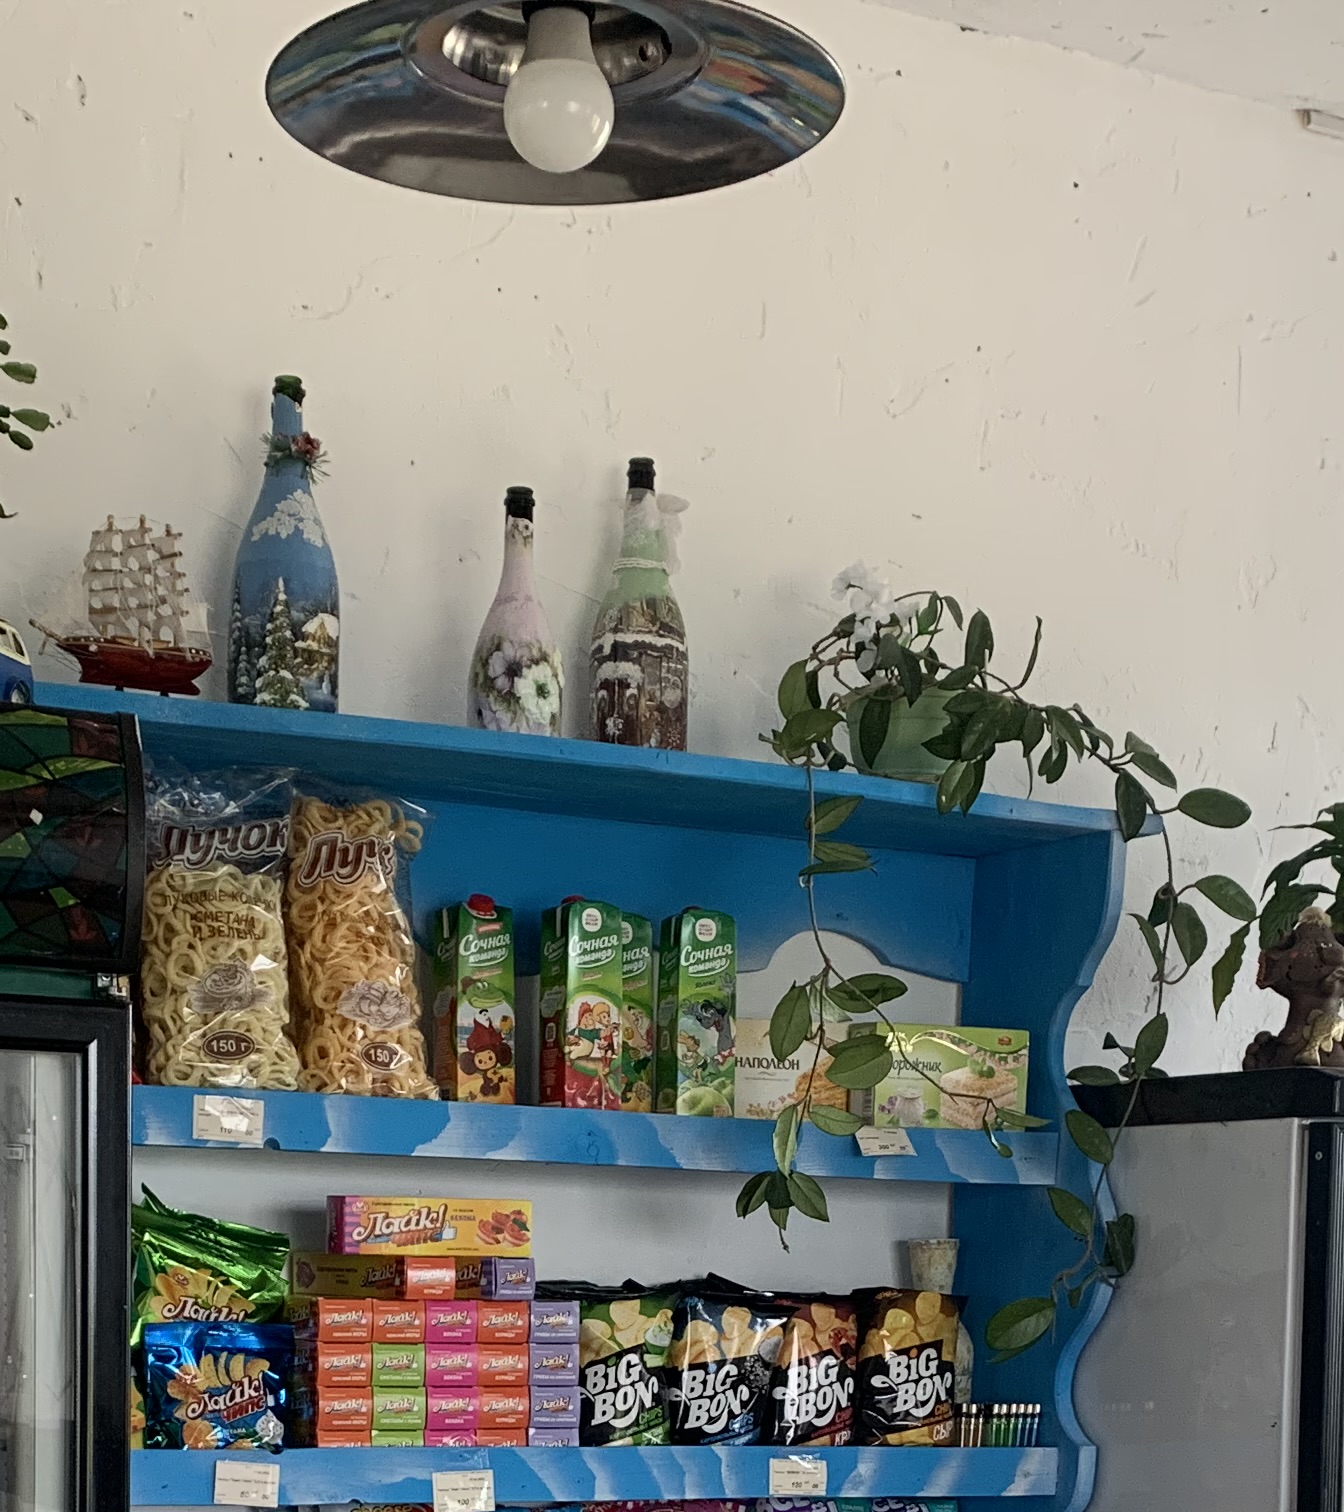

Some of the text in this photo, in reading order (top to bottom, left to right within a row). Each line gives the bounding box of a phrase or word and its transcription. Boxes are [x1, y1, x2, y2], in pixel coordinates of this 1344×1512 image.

[193, 910, 256, 928] СМЕТАНА
[459, 933, 511, 957] Сочная
[569, 934, 619, 957] Сочная
[468, 949, 508, 965] команда
[575, 949, 613, 965] команда
[681, 943, 733, 967] Сочная
[688, 958, 727, 975] команда
[210, 1039, 236, 1053] 150
[368, 1050, 390, 1063] 150
[735, 1056, 800, 1071] НАПОЛЕОН
[891, 1056, 943, 1073] орожник
[352, 1203, 448, 1242] Лайк!
[455, 1264, 482, 1284] айк!
[325, 1310, 363, 1326] Лайк!
[379, 1311, 416, 1327] Лайк!
[431, 1311, 469, 1326] Лайк!
[483, 1312, 519, 1327] Лайк!
[324, 1354, 362, 1370] Лайк!
[377, 1354, 414, 1369] Лайк!
[431, 1354, 468, 1369] Лайк!
[483, 1354, 519, 1370] Лайк!
[534, 1354, 570, 1369] Лайк!
[186, 1371, 264, 1419] Лайк!
[591, 1375, 659, 1428] BON
[794, 1376, 855, 1427] BON
[893, 1371, 953, 1418] BON
[325, 1398, 363, 1414] Лайк!
[377, 1398, 414, 1413] Лайк!
[433, 1398, 470, 1413] Лайк!
[483, 1398, 519, 1413] Лайк!
[535, 1396, 570, 1412] Лайк!
[684, 1384, 750, 1433] BON
